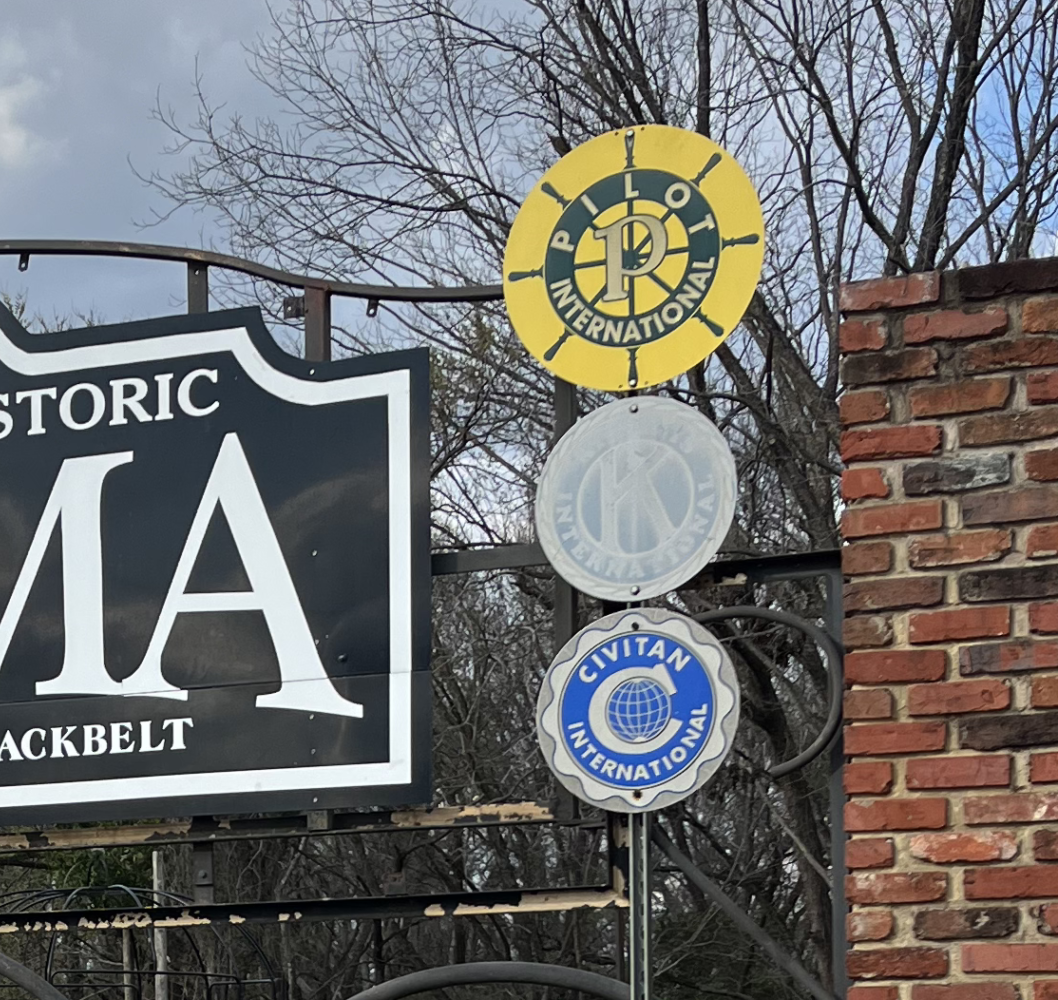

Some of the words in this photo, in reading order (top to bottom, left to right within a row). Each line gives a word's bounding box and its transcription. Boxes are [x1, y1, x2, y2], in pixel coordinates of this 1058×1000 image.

[550, 172, 716, 252] PILOT
[549, 256, 715, 343] INTERNATIONAL
[578, 637, 692, 684] CIVITAN
[567, 703, 709, 782] INTERNATIONAL
